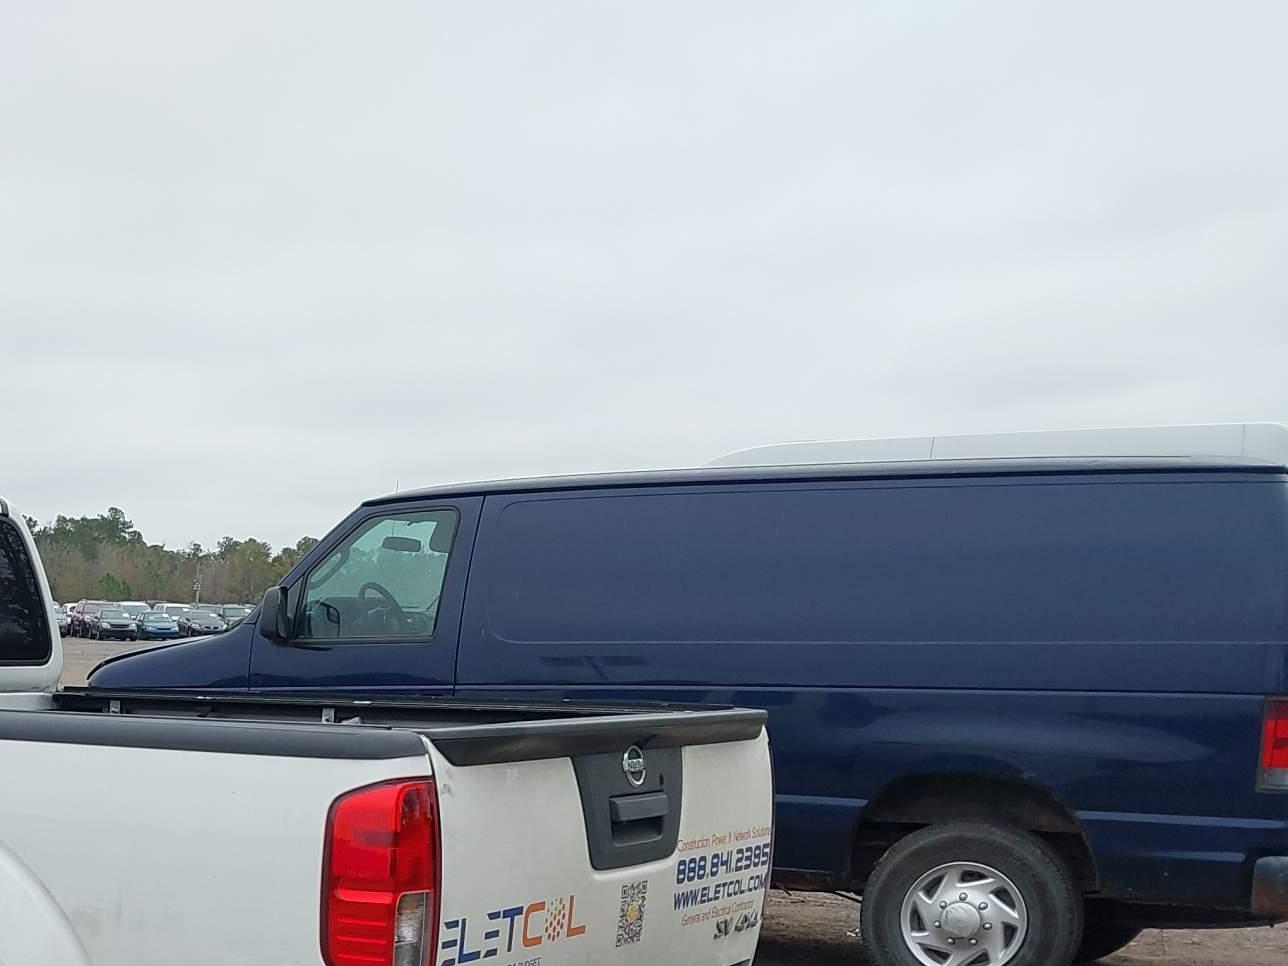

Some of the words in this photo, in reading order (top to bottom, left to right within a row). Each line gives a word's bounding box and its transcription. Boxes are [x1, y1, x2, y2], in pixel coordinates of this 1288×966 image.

[682, 911, 700, 926] General
[701, 910, 711, 921] and
[714, 917, 733, 940] SV
